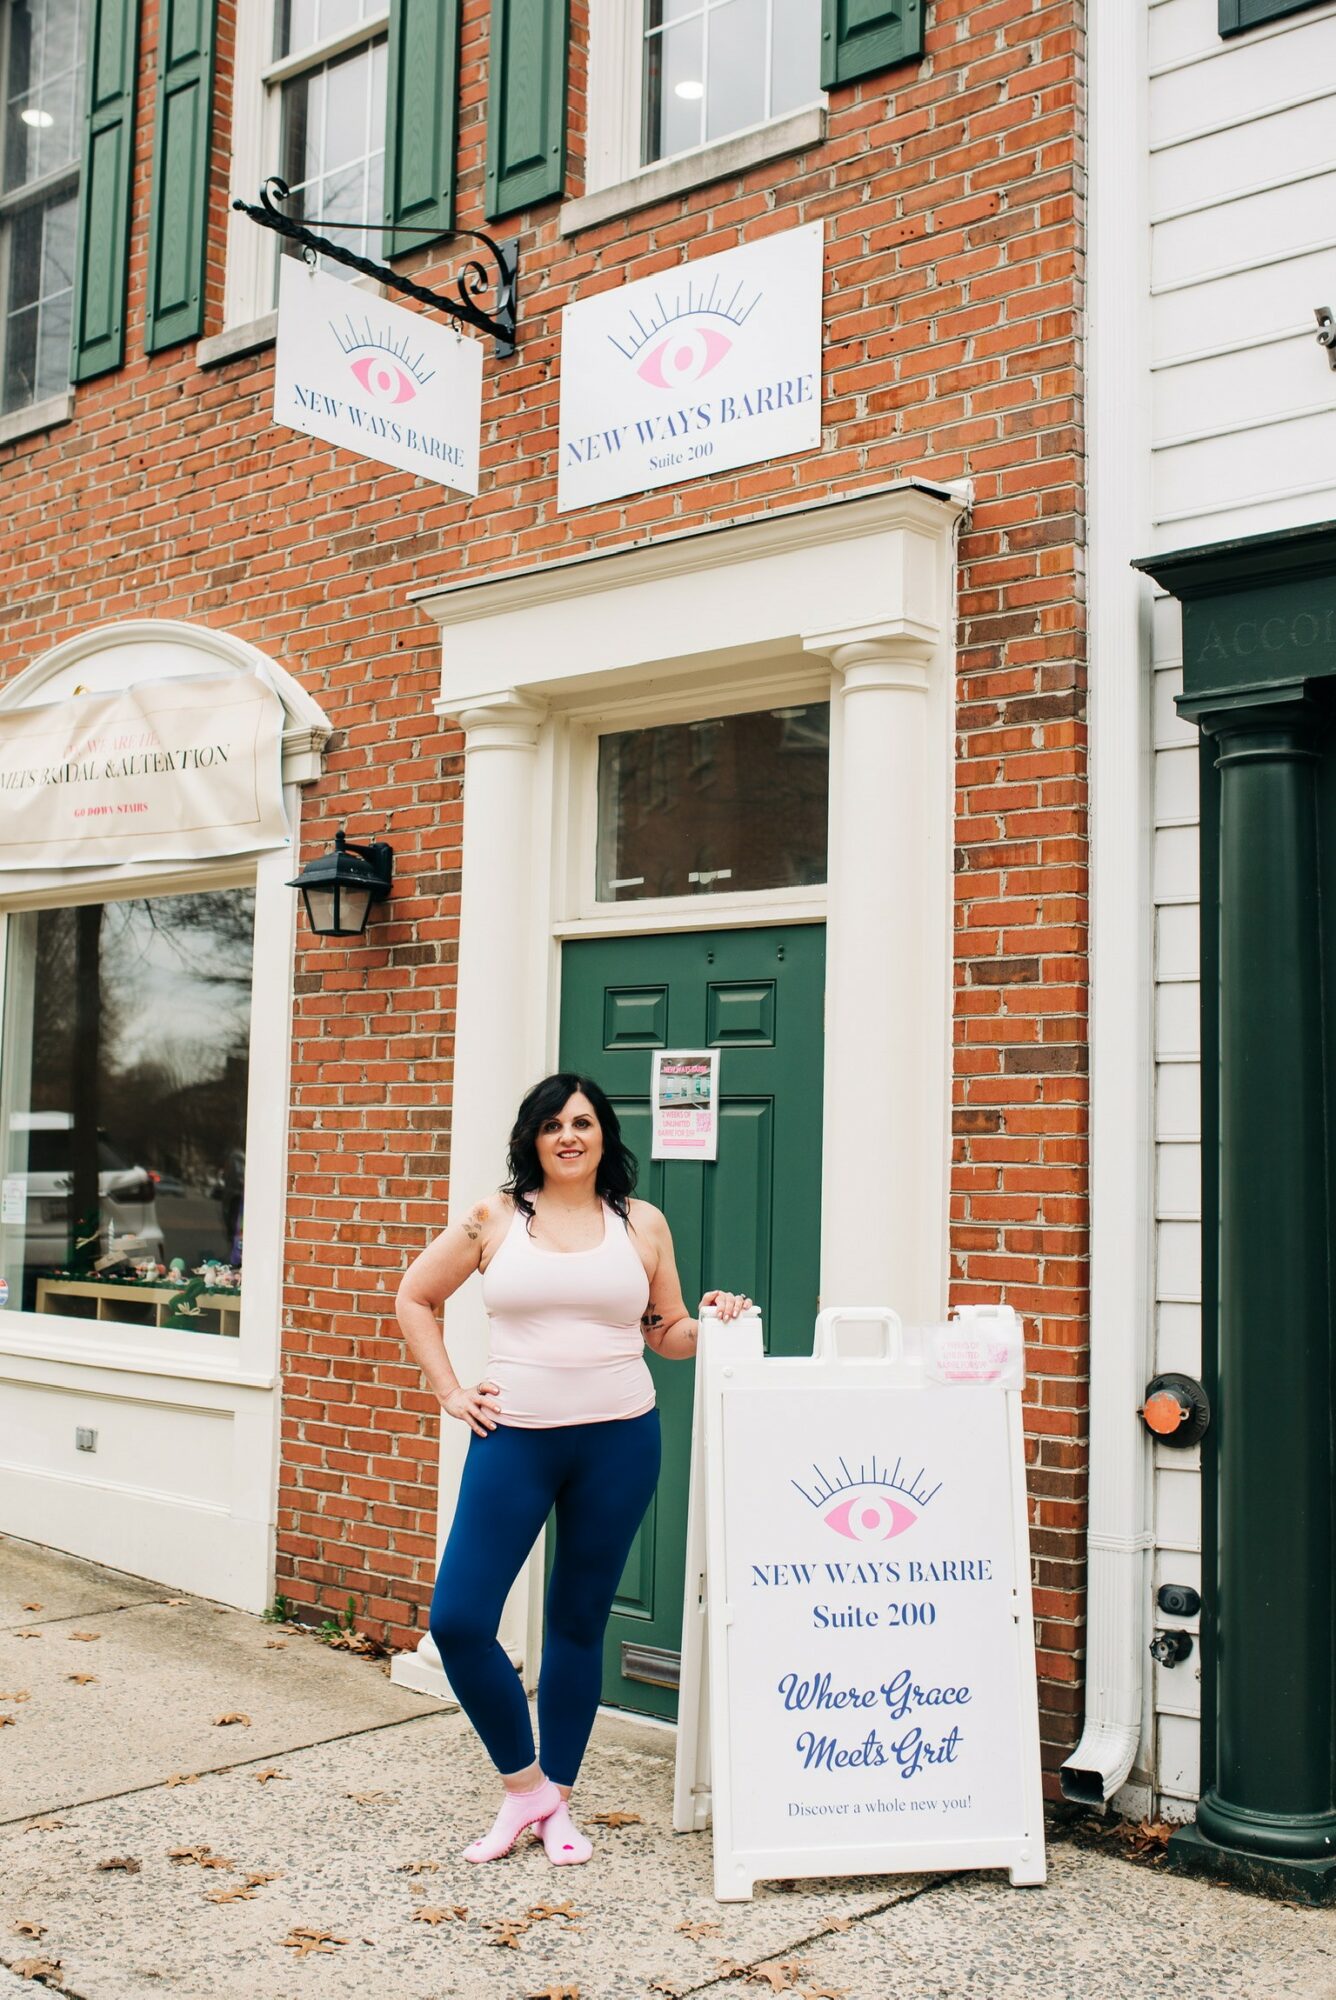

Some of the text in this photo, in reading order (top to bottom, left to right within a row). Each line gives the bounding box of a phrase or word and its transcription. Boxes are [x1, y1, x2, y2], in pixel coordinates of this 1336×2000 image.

[294, 384, 465, 468] NEW WAYS BARRE
[567, 374, 813, 466] NEW WAYS BARRE
[649, 441, 714, 471] Suite 200
[87, 805, 113, 816] DOWN
[116, 802, 149, 814] STAIRS
[751, 1559, 993, 1586] NEW WAYS BARRE
[813, 1602, 936, 1629] Suite 200
[778, 1669, 972, 1720] Where Grace
[796, 1725, 964, 1779] Meets Grit
[788, 1795, 972, 1817] Discover a whole new you!
